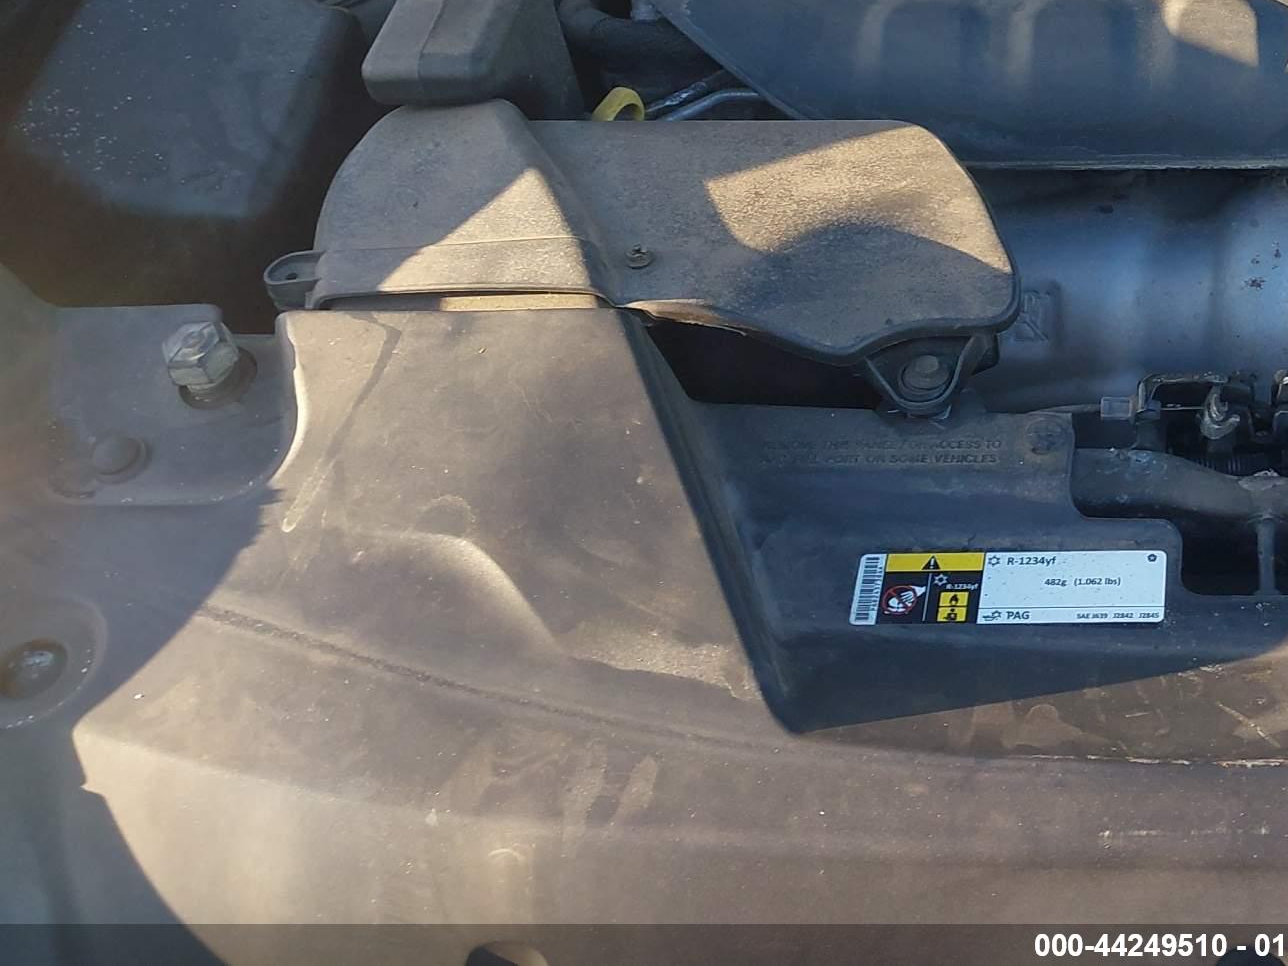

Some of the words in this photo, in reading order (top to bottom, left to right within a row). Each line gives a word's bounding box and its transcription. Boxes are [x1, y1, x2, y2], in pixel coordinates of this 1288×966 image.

[983, 438, 1003, 450] TO
[932, 452, 998, 465] VEHICLES
[1006, 555, 1057, 568] R-1234yf
[1043, 577, 1068, 587] 482g
[1073, 577, 1103, 587] (1.062
[1104, 576, 1122, 587] lbs)
[1006, 610, 1031, 621] PAG
